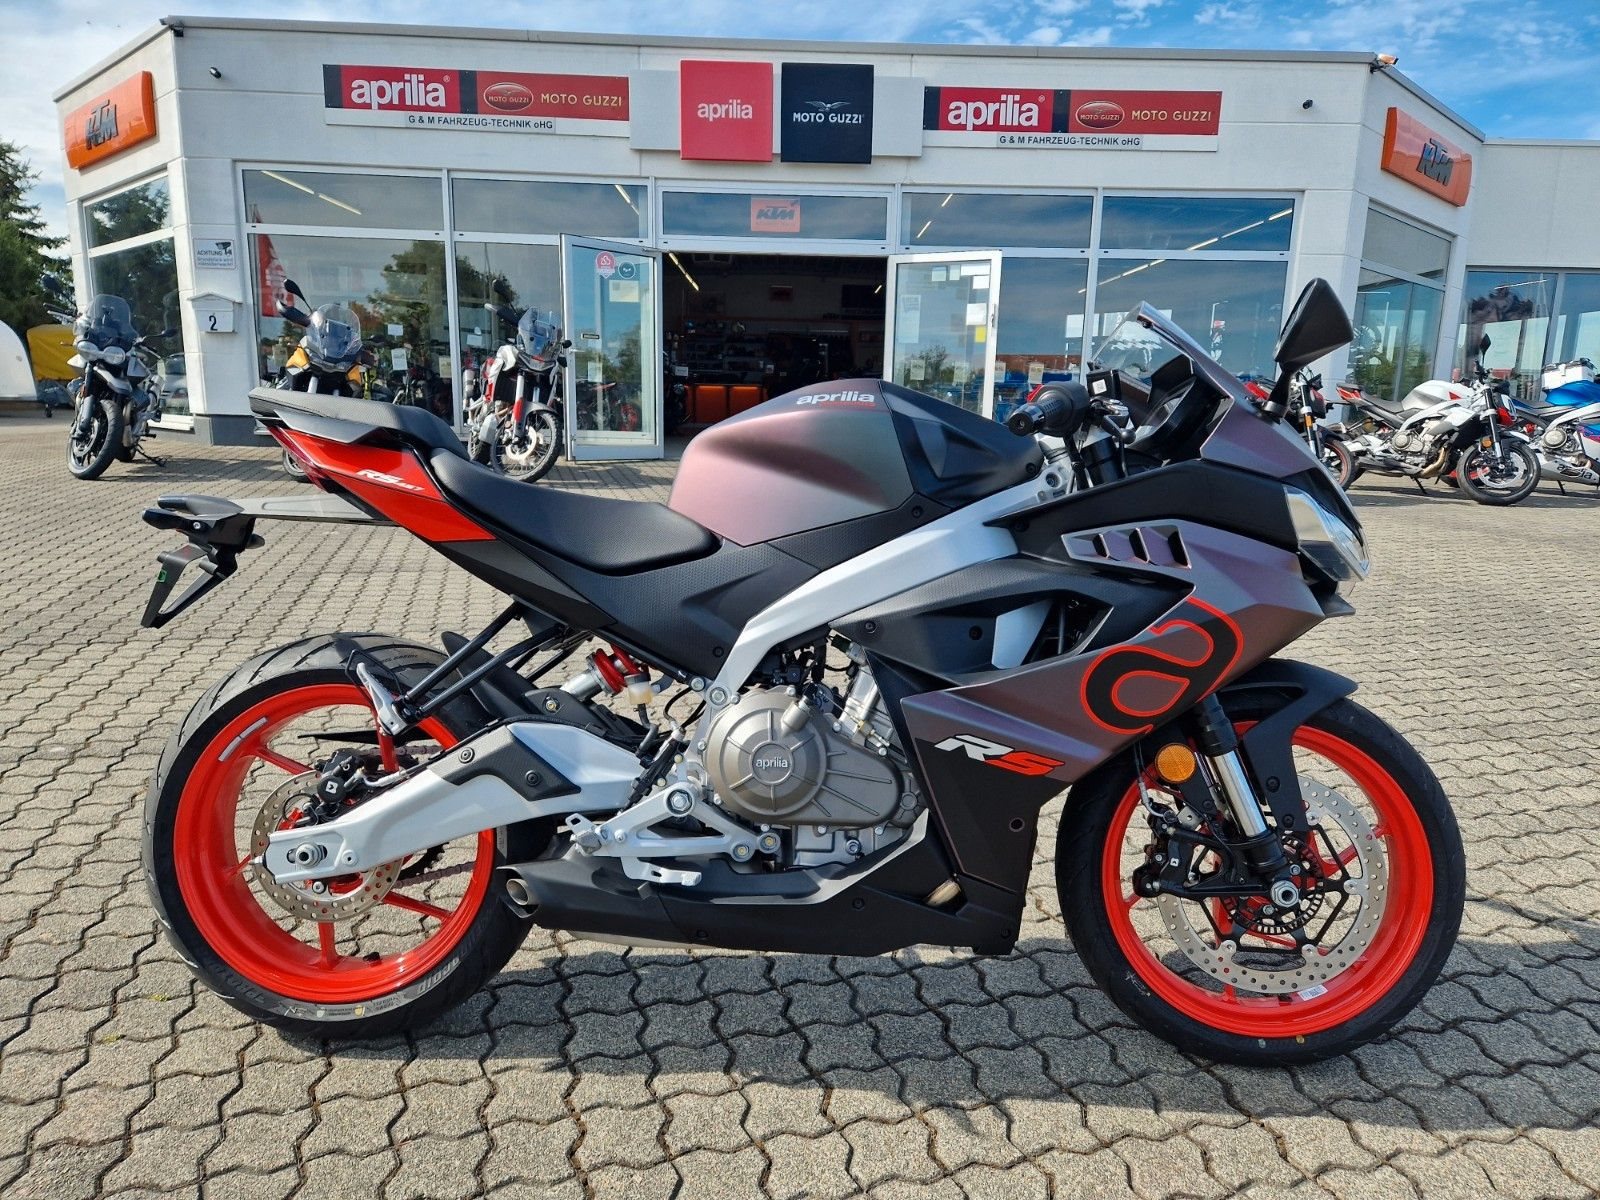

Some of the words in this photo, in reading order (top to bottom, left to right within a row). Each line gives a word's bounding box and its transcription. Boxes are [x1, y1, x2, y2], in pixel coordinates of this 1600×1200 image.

[541, 93, 577, 105] MOTO
[583, 95, 622, 107] GUZZI
[697, 99, 753, 122] aprilia
[1131, 110, 1168, 121] MOTO
[1172, 111, 1211, 122] GUZZI
[86, 99, 119, 150] KTM
[408, 115, 416, 124] G
[418, 115, 425, 124] &
[427, 116, 435, 125] M
[437, 116, 531, 129] FAHRZEUG-TECHNIK
[793, 112, 824, 124] MOTO
[829, 113, 862, 124] GUZZI
[999, 135, 1007, 145] G
[1008, 135, 1015, 145] &
[1017, 136, 1025, 145] M
[1028, 136, 1119, 146] FAHRZEUG-TECHNIK
[1416, 138, 1454, 186] KTM
[756, 205, 796, 220] KTM
[208, 315, 218, 331] 2
[796, 391, 875, 405] aprilia
[934, 734, 1066, 776] RS
[755, 757, 788, 770] aprilia
